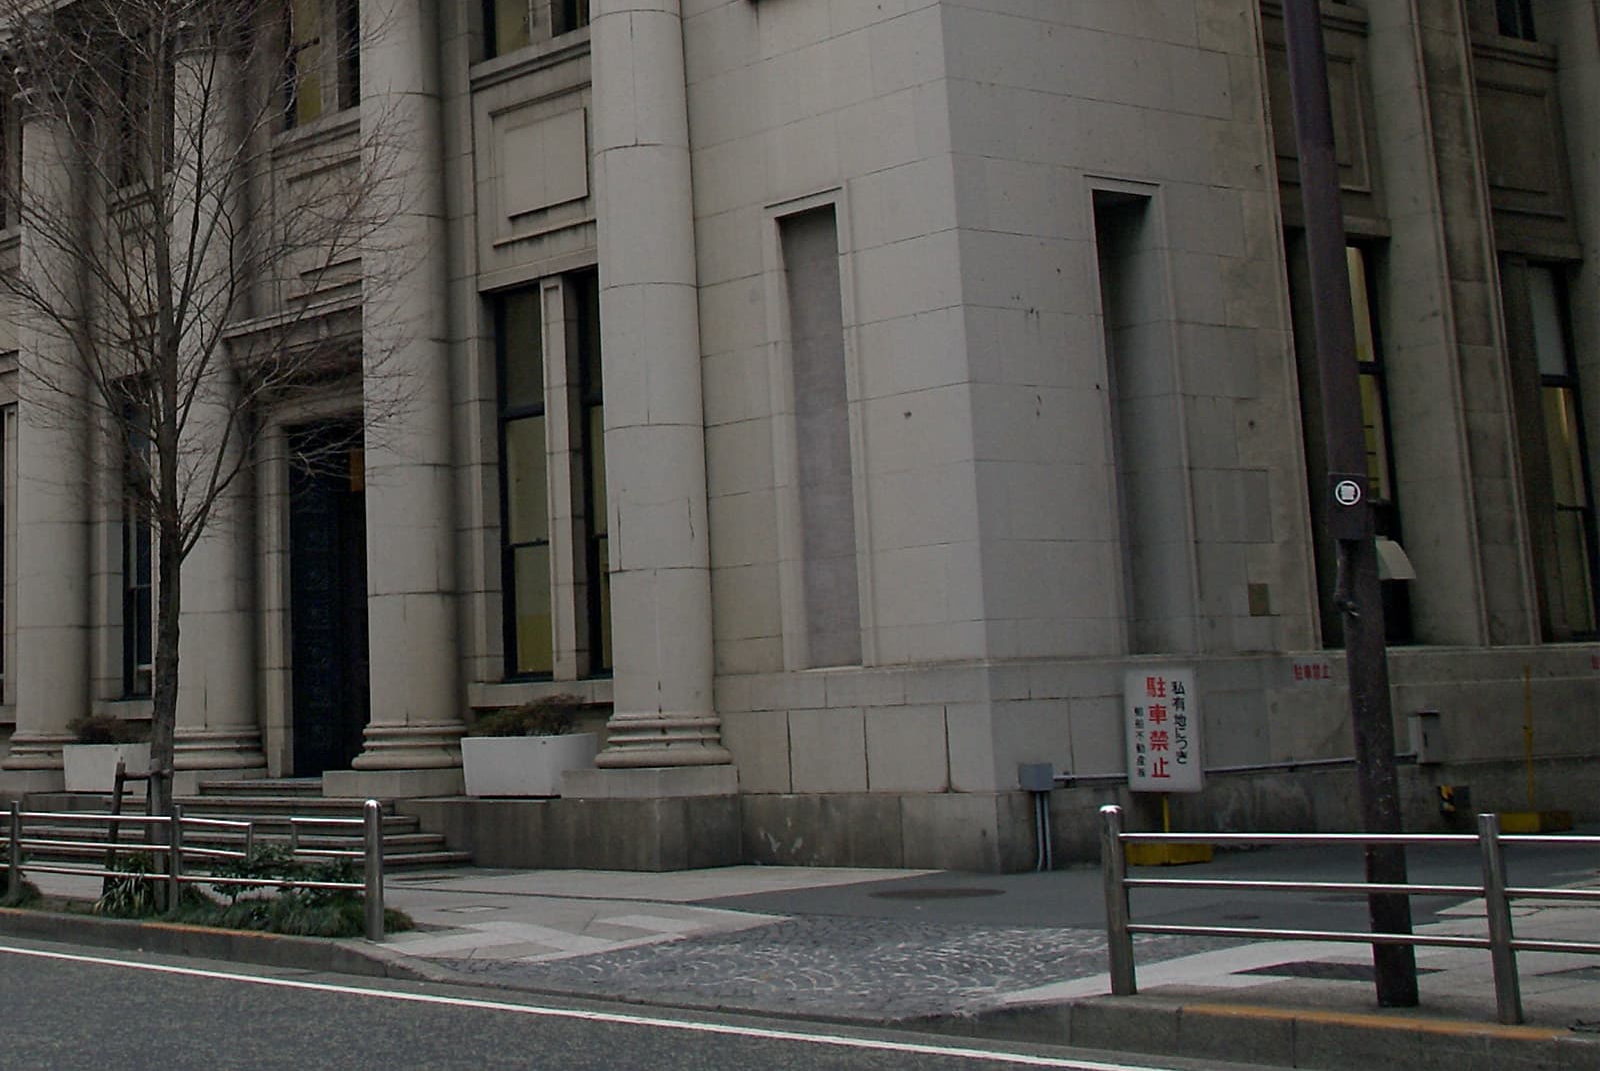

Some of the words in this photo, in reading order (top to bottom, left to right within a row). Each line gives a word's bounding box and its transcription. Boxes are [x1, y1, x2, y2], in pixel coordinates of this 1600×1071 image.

[1146, 676, 1170, 778] 駐車禁止
[1171, 680, 1188, 764] 私有地につき
